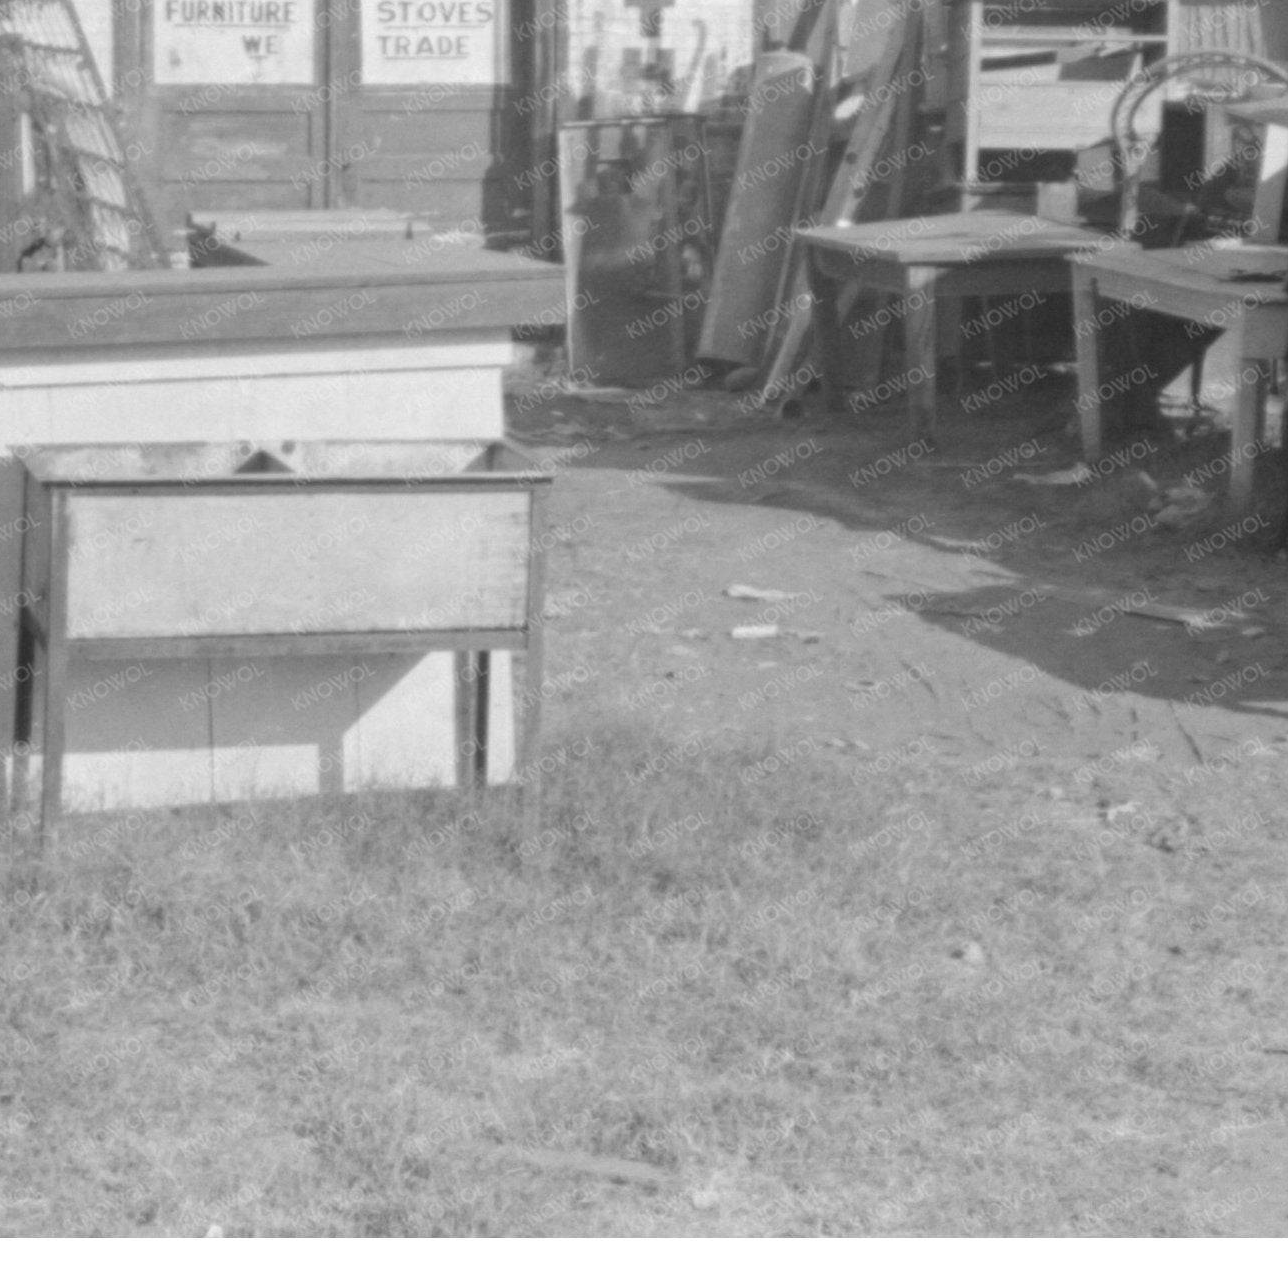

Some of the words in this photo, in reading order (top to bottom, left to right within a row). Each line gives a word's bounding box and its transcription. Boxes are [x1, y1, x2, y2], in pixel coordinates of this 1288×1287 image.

[165, 0, 297, 23] FURNITURE
[376, 0, 494, 24] STOVES
[242, 35, 279, 55] WE
[376, 35, 470, 56] TRADE
